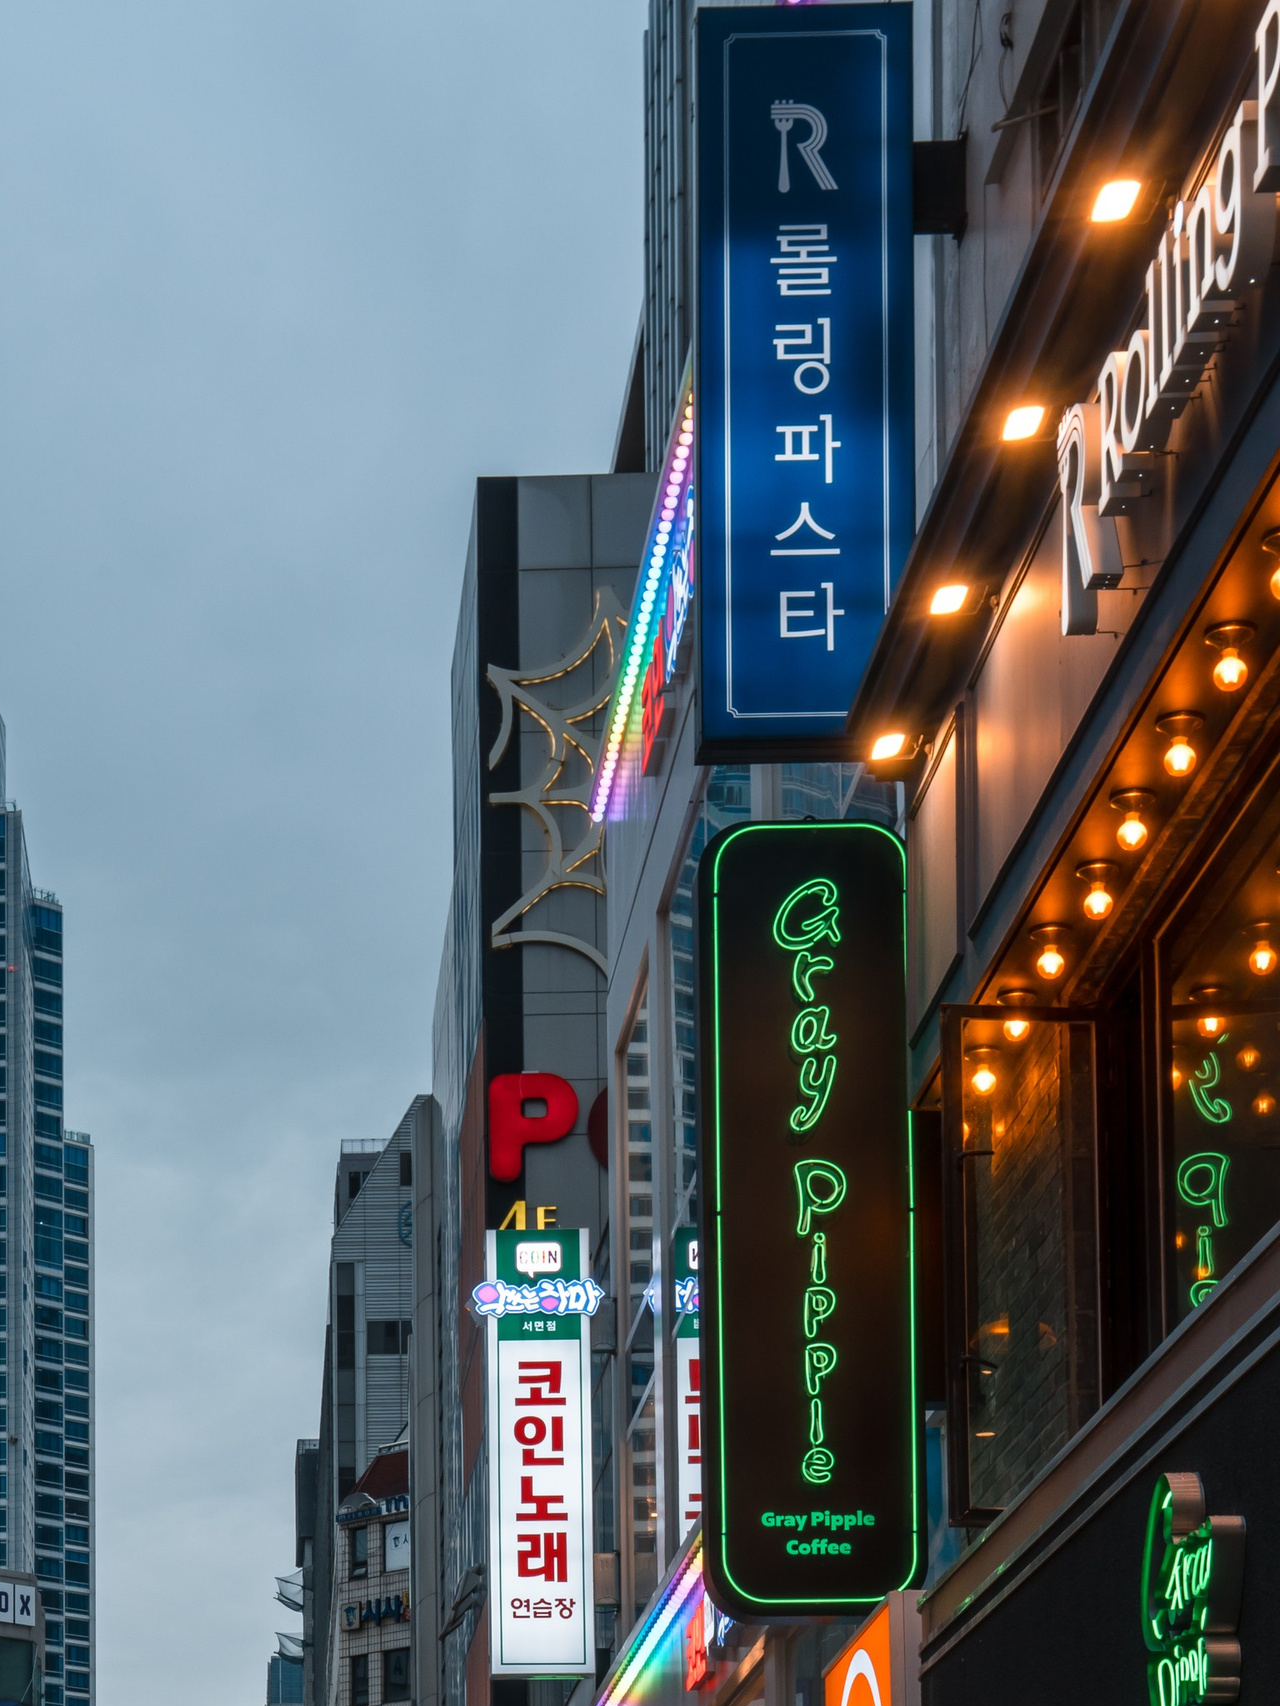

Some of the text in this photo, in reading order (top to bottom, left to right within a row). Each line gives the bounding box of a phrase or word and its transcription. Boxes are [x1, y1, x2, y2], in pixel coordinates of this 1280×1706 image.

[1099, 114, 1245, 515] Rolling
[769, 223, 845, 652] 롤링파스타
[773, 879, 841, 1133] Gray
[488, 1072, 608, 1182] P
[519, 1250, 558, 1264] COIN
[522, 1320, 557, 1332] 서면점
[794, 1158, 847, 1486] Pipple
[513, 1360, 569, 1583] 코인노래
[761, 1510, 875, 1531] Gray Pipple
[786, 1538, 853, 1556] Coffee
[510, 1597, 576, 1620] 연습장
